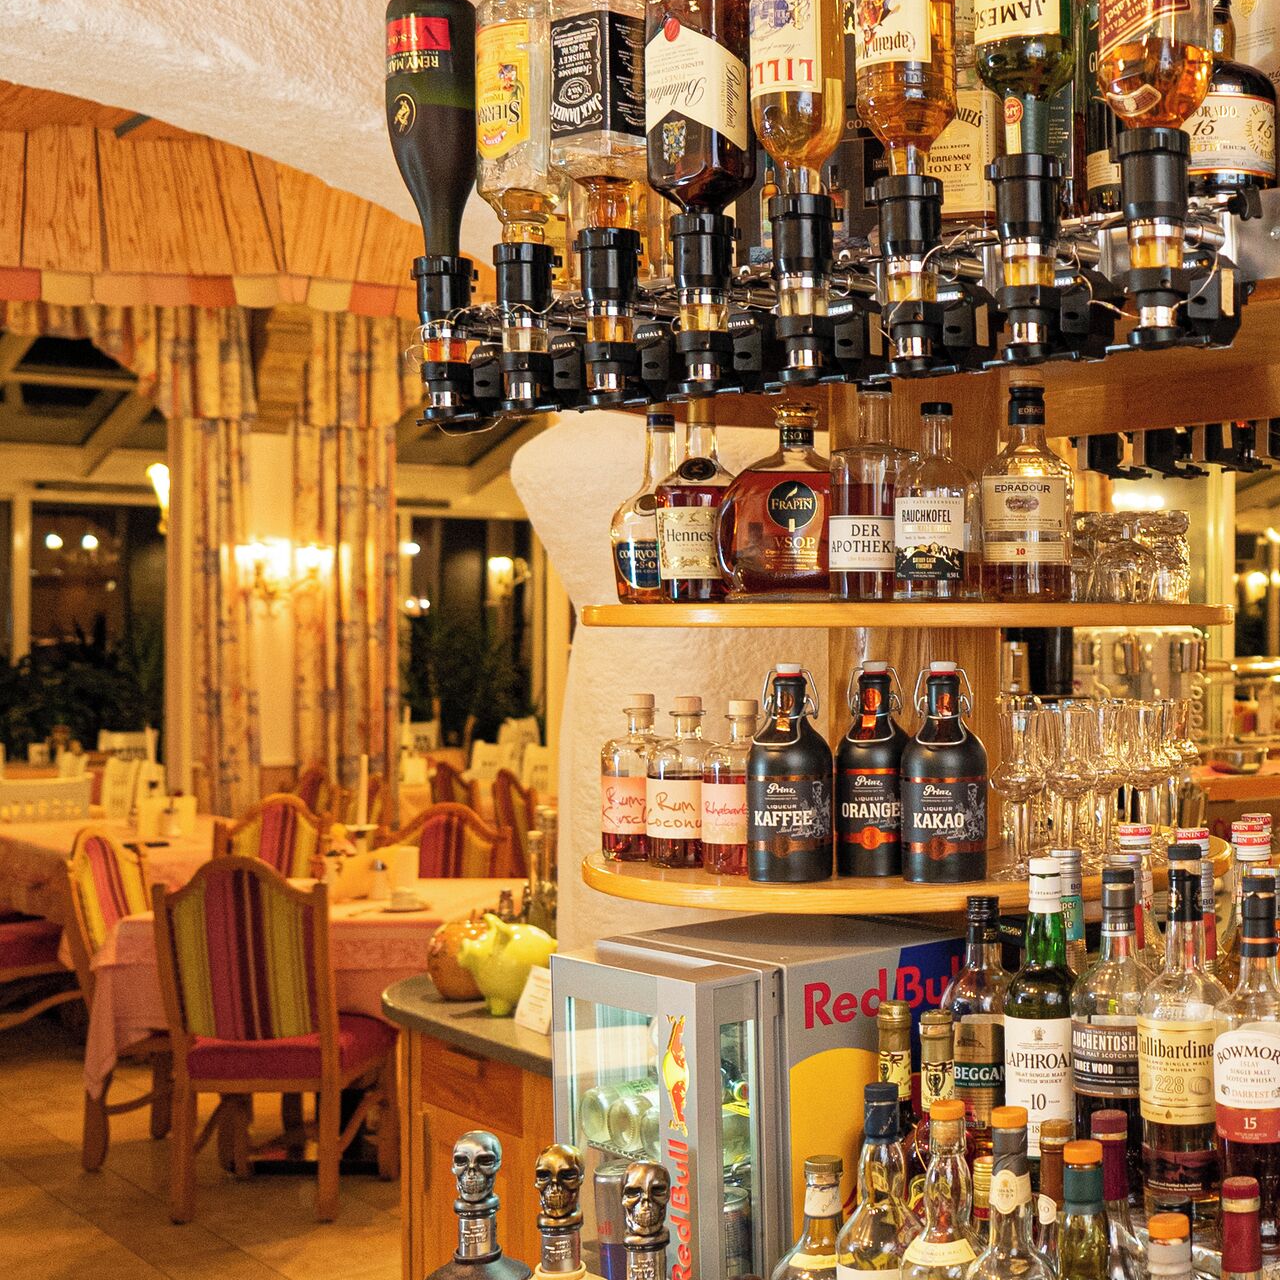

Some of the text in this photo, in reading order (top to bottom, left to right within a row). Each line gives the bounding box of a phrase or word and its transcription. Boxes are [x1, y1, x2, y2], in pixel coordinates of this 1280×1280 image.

[875, 31, 916, 55] Captain
[558, 51, 591, 64] WHISKEY
[557, 64, 593, 78] Tennessee
[579, 92, 604, 117] JACK
[1192, 120, 1215, 137] 15
[1257, 121, 1273, 138] 15
[994, 484, 1051, 493] EDRADOUR
[771, 497, 813, 510] FRAPIN
[901, 509, 952, 523] RAUCHKOFEL
[666, 528, 714, 543] Hennes
[850, 524, 881, 537] DER
[1015, 548, 1026, 556] 10
[766, 782, 797, 795] Prinz
[854, 775, 884, 787] Prinz
[923, 784, 952, 796] Prinz
[655, 791, 696, 813] Rum
[841, 802, 901, 818] ORANGE
[754, 810, 813, 827] KAFFEE
[913, 812, 965, 829] KAKAO
[803, 967, 889, 1030] Red
[1139, 1033, 1214, 1059] Tullibardine
[1074, 1059, 1114, 1074] THREE WOOD
[1155, 1074, 1185, 1094] 228
[1030, 1094, 1046, 1110] 10
[1243, 1117, 1257, 1130] 15
[667, 1138, 692, 1213] Bull
